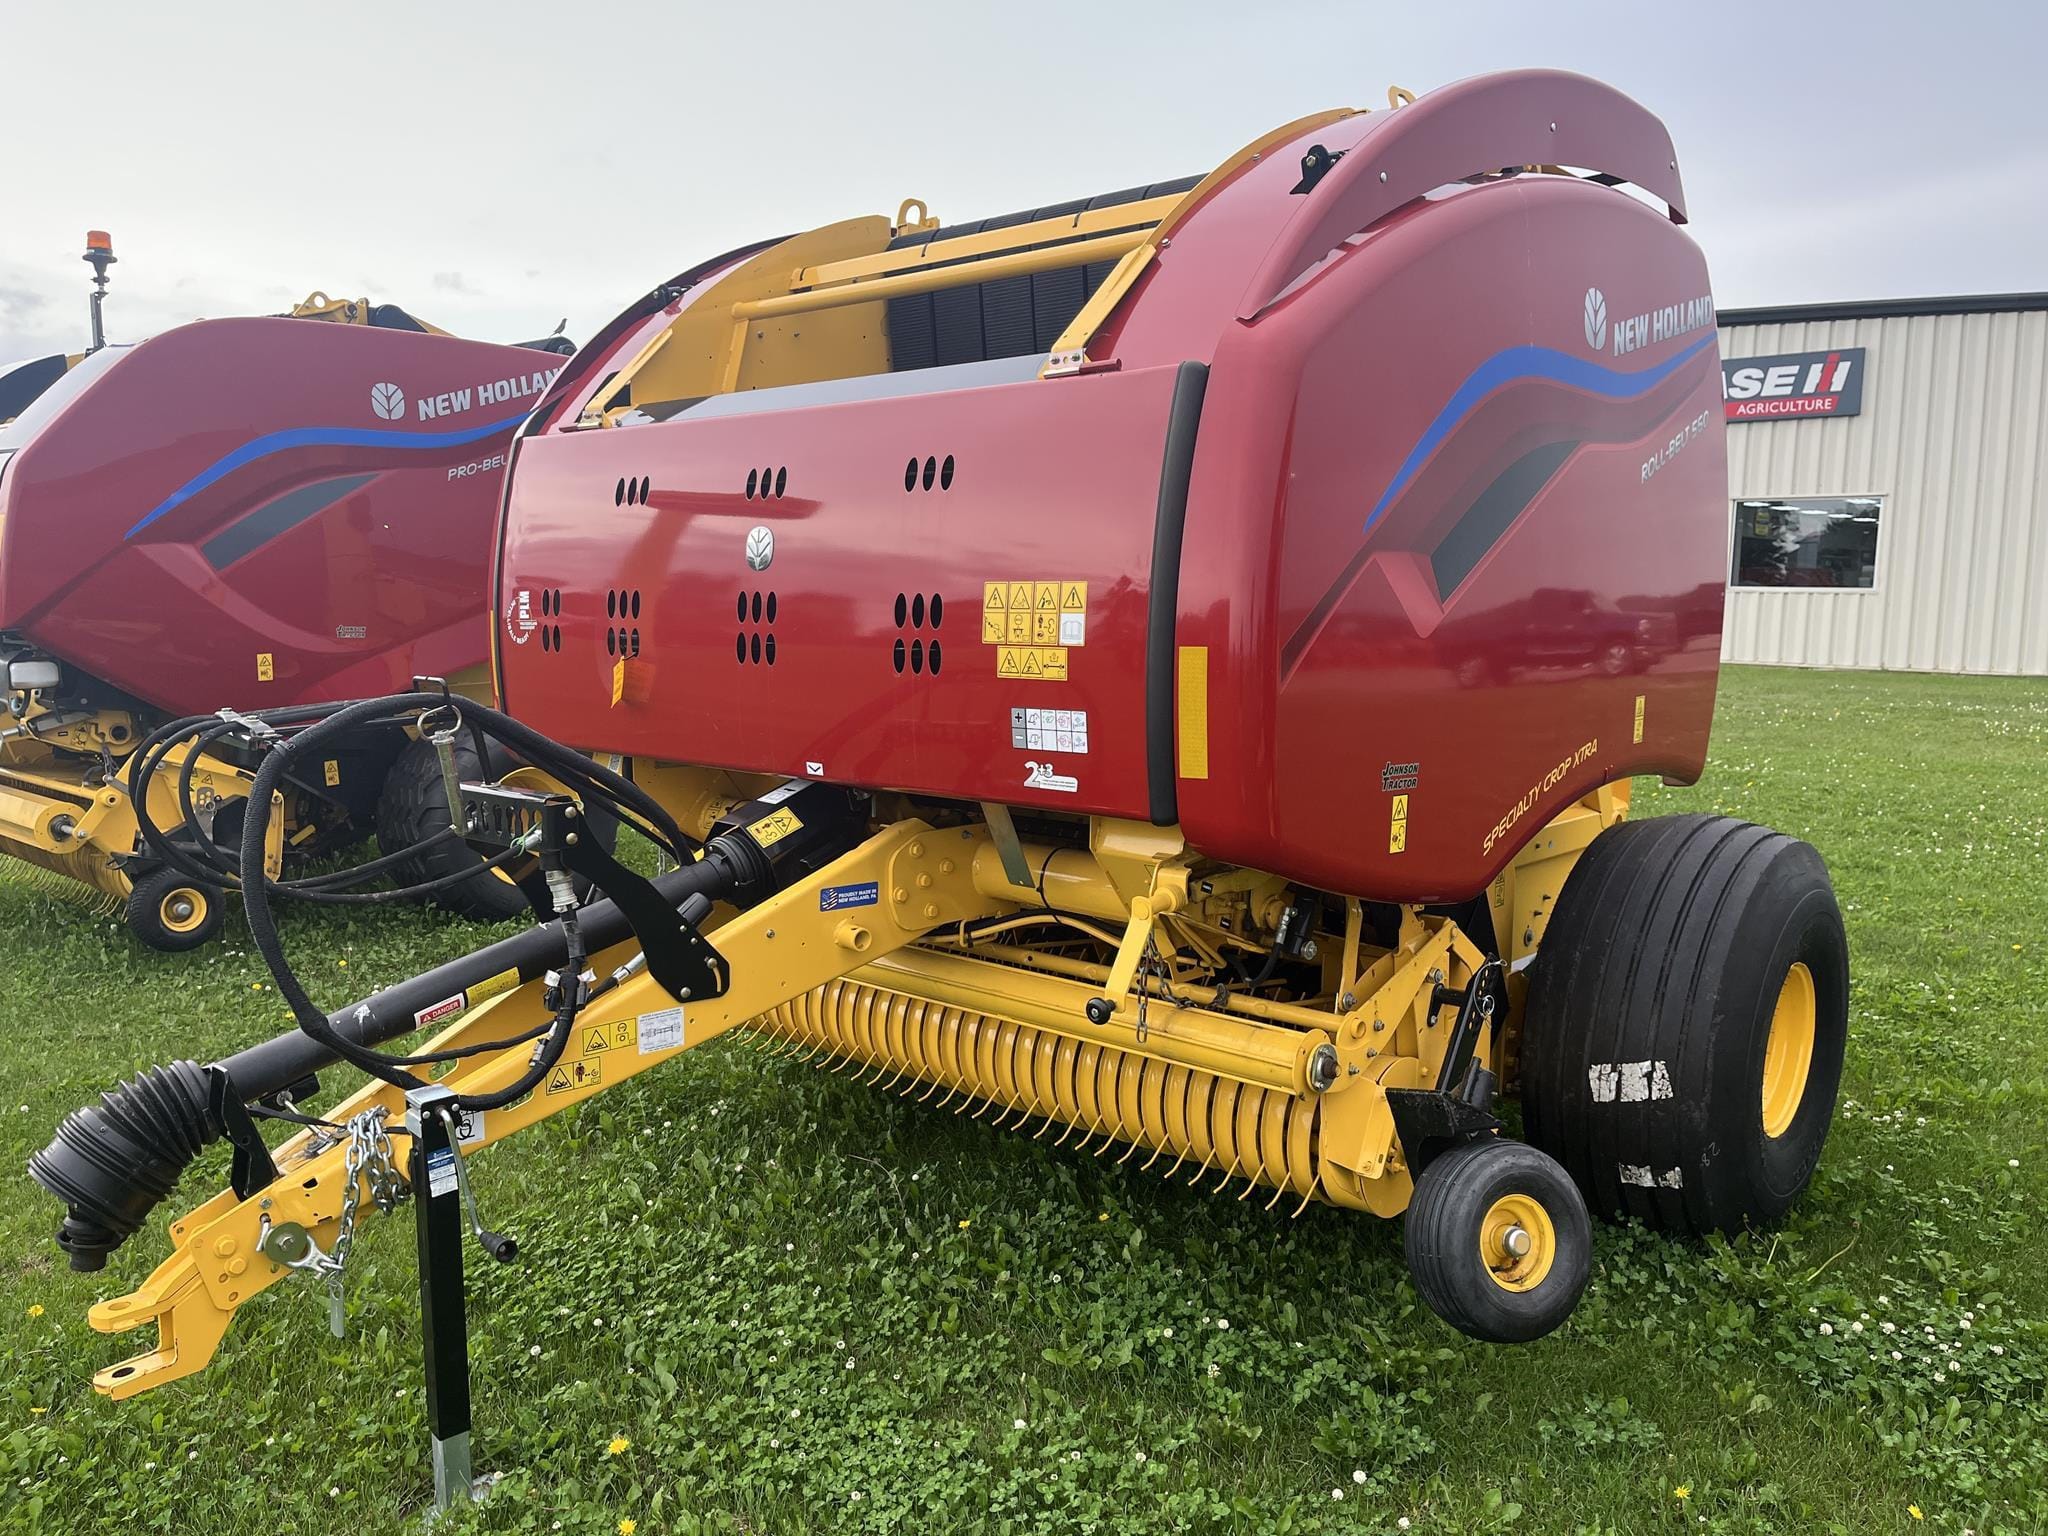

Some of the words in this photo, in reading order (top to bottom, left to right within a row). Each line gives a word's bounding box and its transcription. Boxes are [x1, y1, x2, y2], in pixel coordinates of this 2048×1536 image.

[1614, 313, 1649, 356] NEW
[1652, 295, 1713, 343] HOLLAND
[1722, 365, 1800, 399] SE
[418, 388, 471, 422] NEW
[1736, 398, 1833, 415] AGRICULTURE
[1641, 425, 1690, 484] ROLL-BELT
[519, 591, 530, 619] PLM
[1382, 761, 1420, 776] JOHNSON
[1382, 776, 1418, 792] TRACTOR
[1483, 781, 1542, 856] SPECIALTY
[1543, 757, 1572, 793] CROP
[1573, 738, 1598, 769] XTRA
[432, 1001, 459, 1018] DANGER
